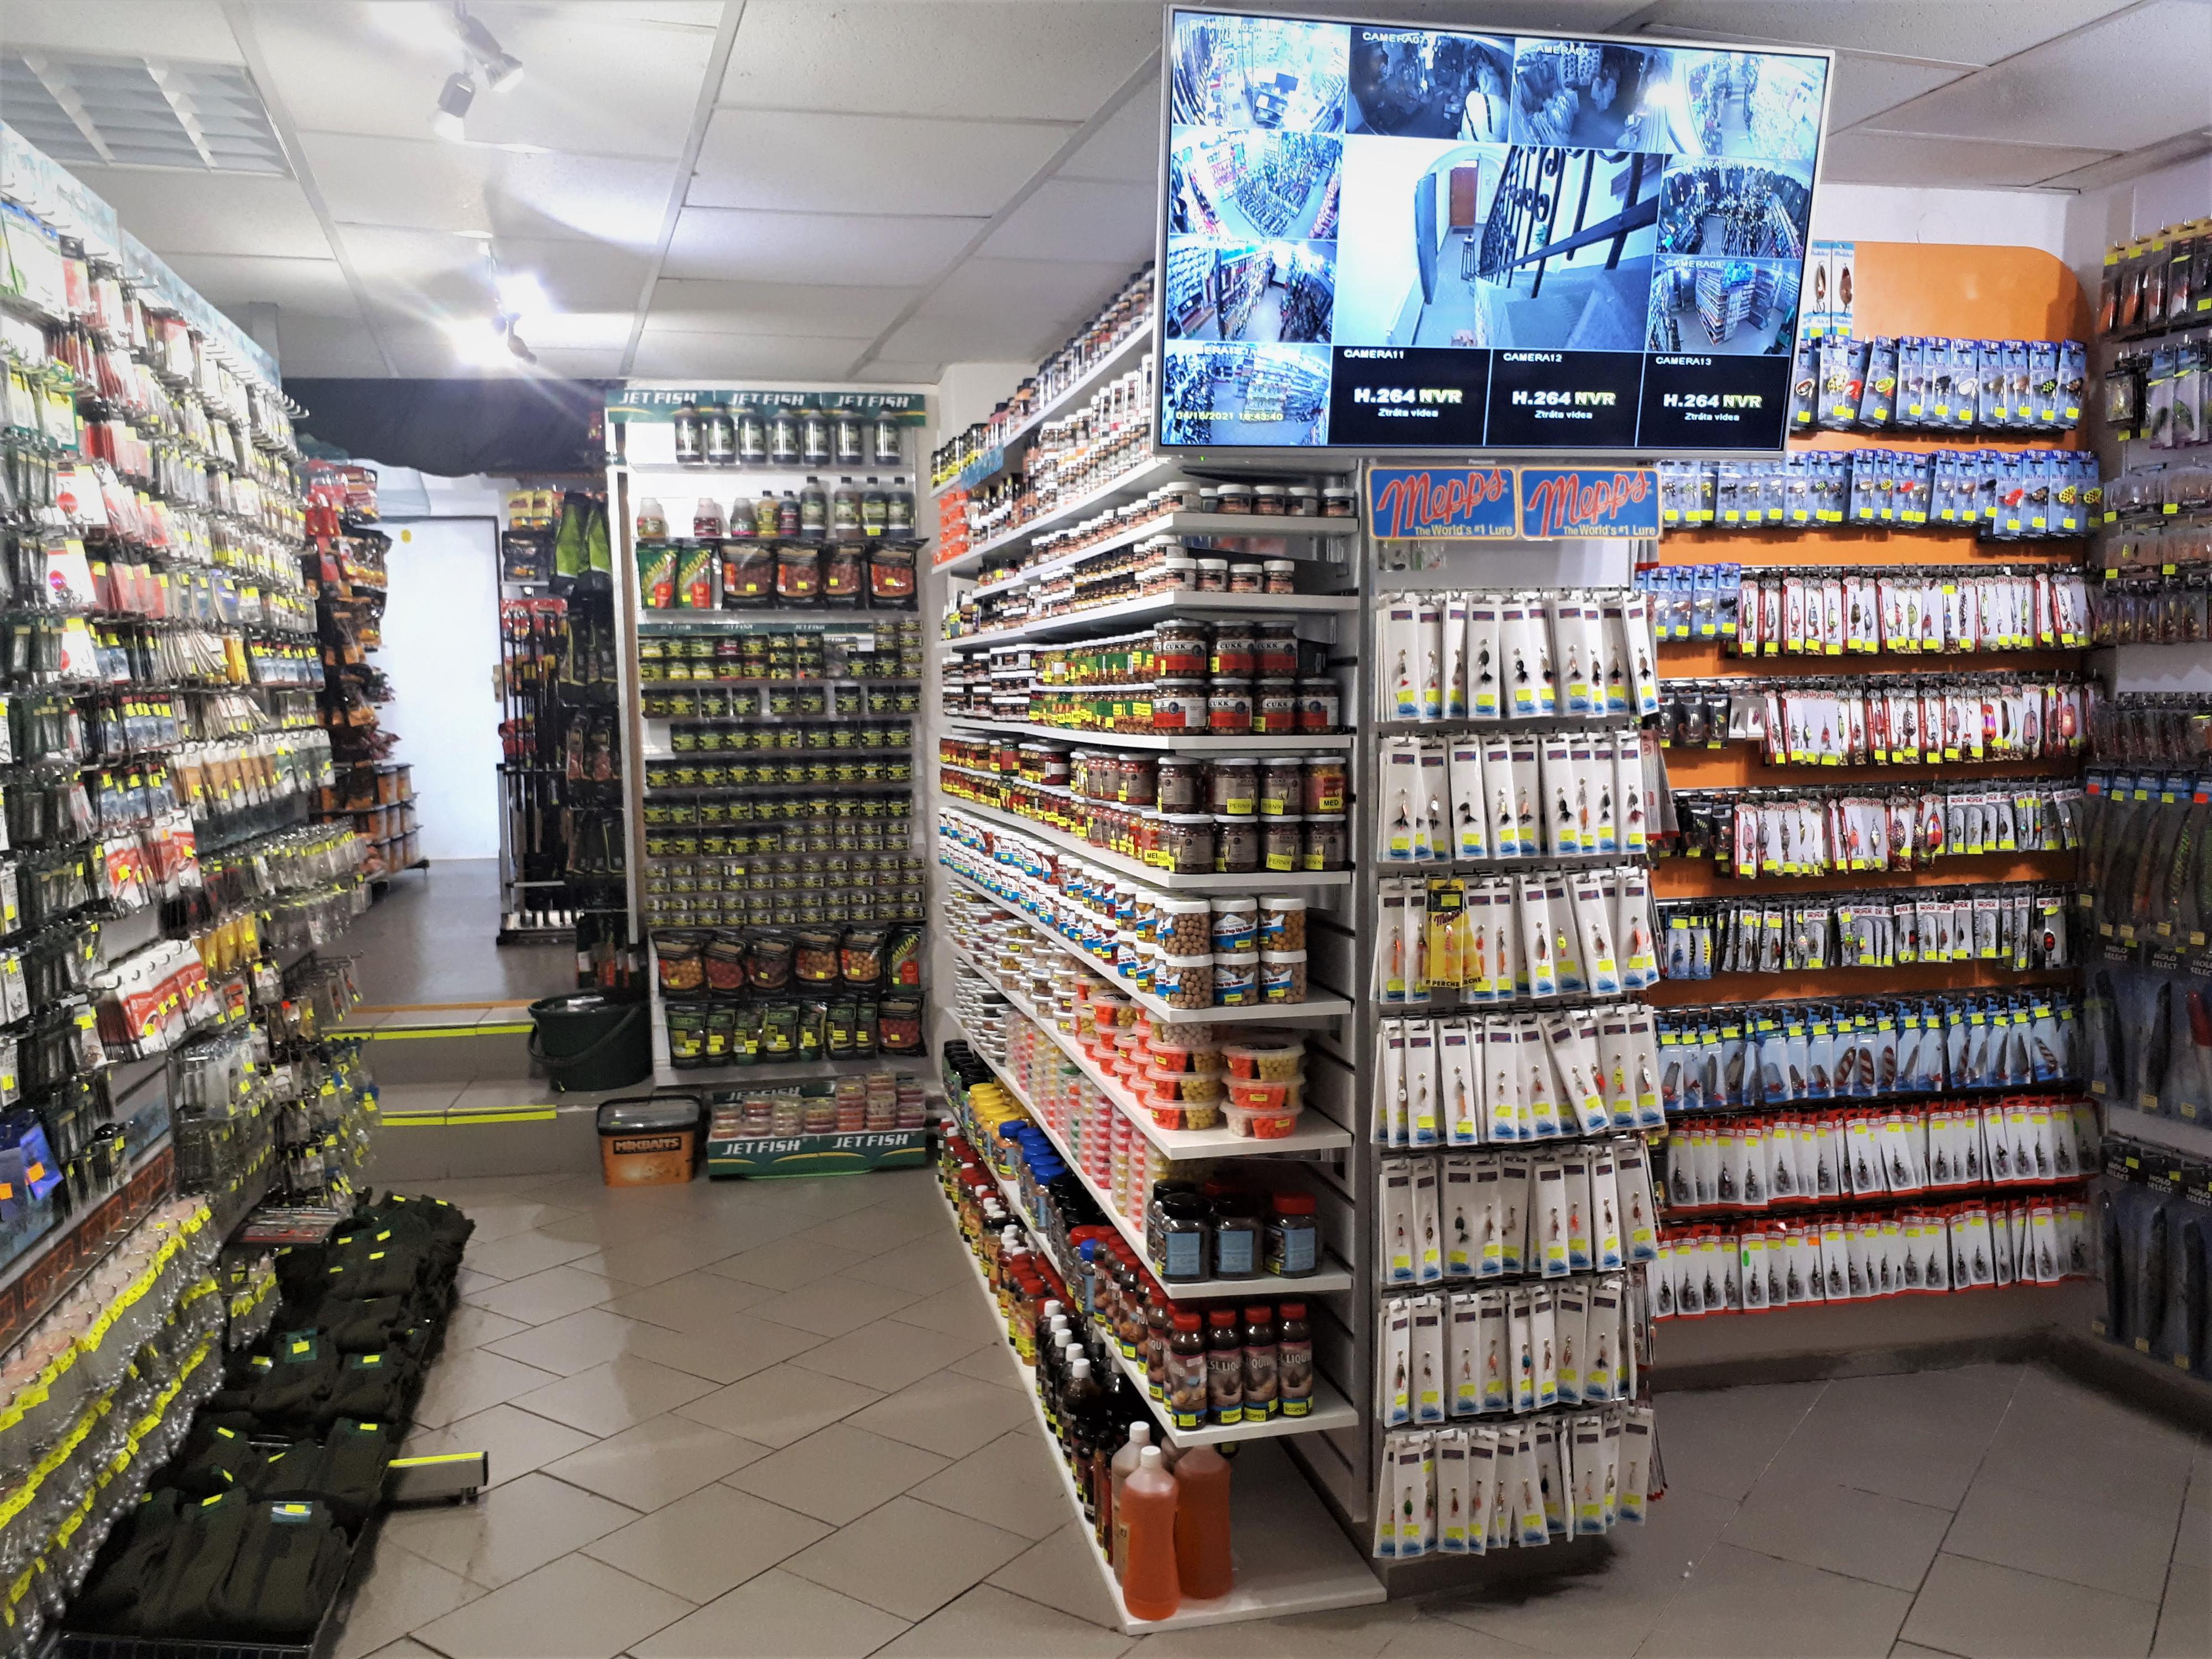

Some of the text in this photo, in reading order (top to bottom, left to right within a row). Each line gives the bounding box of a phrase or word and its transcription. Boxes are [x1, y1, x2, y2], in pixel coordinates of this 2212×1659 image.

[1362, 32, 1428, 44] CAMERA07
[1665, 259, 1723, 269] CAMERA09
[1344, 349, 1404, 359] CAMERA11
[1503, 353, 1562, 363] CAMERA12
[1656, 357, 1712, 366] CAMERA13
[619, 392, 697, 405] JET FISH
[728, 393, 806, 406] JET FISH
[834, 395, 910, 408] JET FISH
[1354, 388, 1463, 404] H.264 NVR
[1512, 390, 1616, 406] H.264 NVR
[1663, 394, 1763, 408] H.264 NVR
[1378, 408, 1438, 418] Ztráta videa
[1535, 410, 1593, 420] Ztráta videa
[1684, 412, 1740, 422] Ztráta videa
[1376, 468, 1507, 538] Mepps
[1526, 470, 1650, 538] Mepps
[1414, 525, 1431, 535] The
[1431, 524, 1473, 536] World's
[1489, 524, 1512, 536] Lure
[1563, 525, 1580, 535] The
[1579, 524, 1618, 535] World's
[1632, 524, 1656, 536] Lure
[2105, 945, 2128, 955] HOLO
[2104, 952, 2128, 962] SELECT
[2153, 952, 2177, 962] HOLO
[2151, 959, 2178, 970] SELECT
[2190, 966, 2212, 977] SELEC
[1465, 977, 1482, 985] RCHE
[832, 1133, 910, 1149] JET FISH
[721, 1139, 801, 1155] JET FISH
